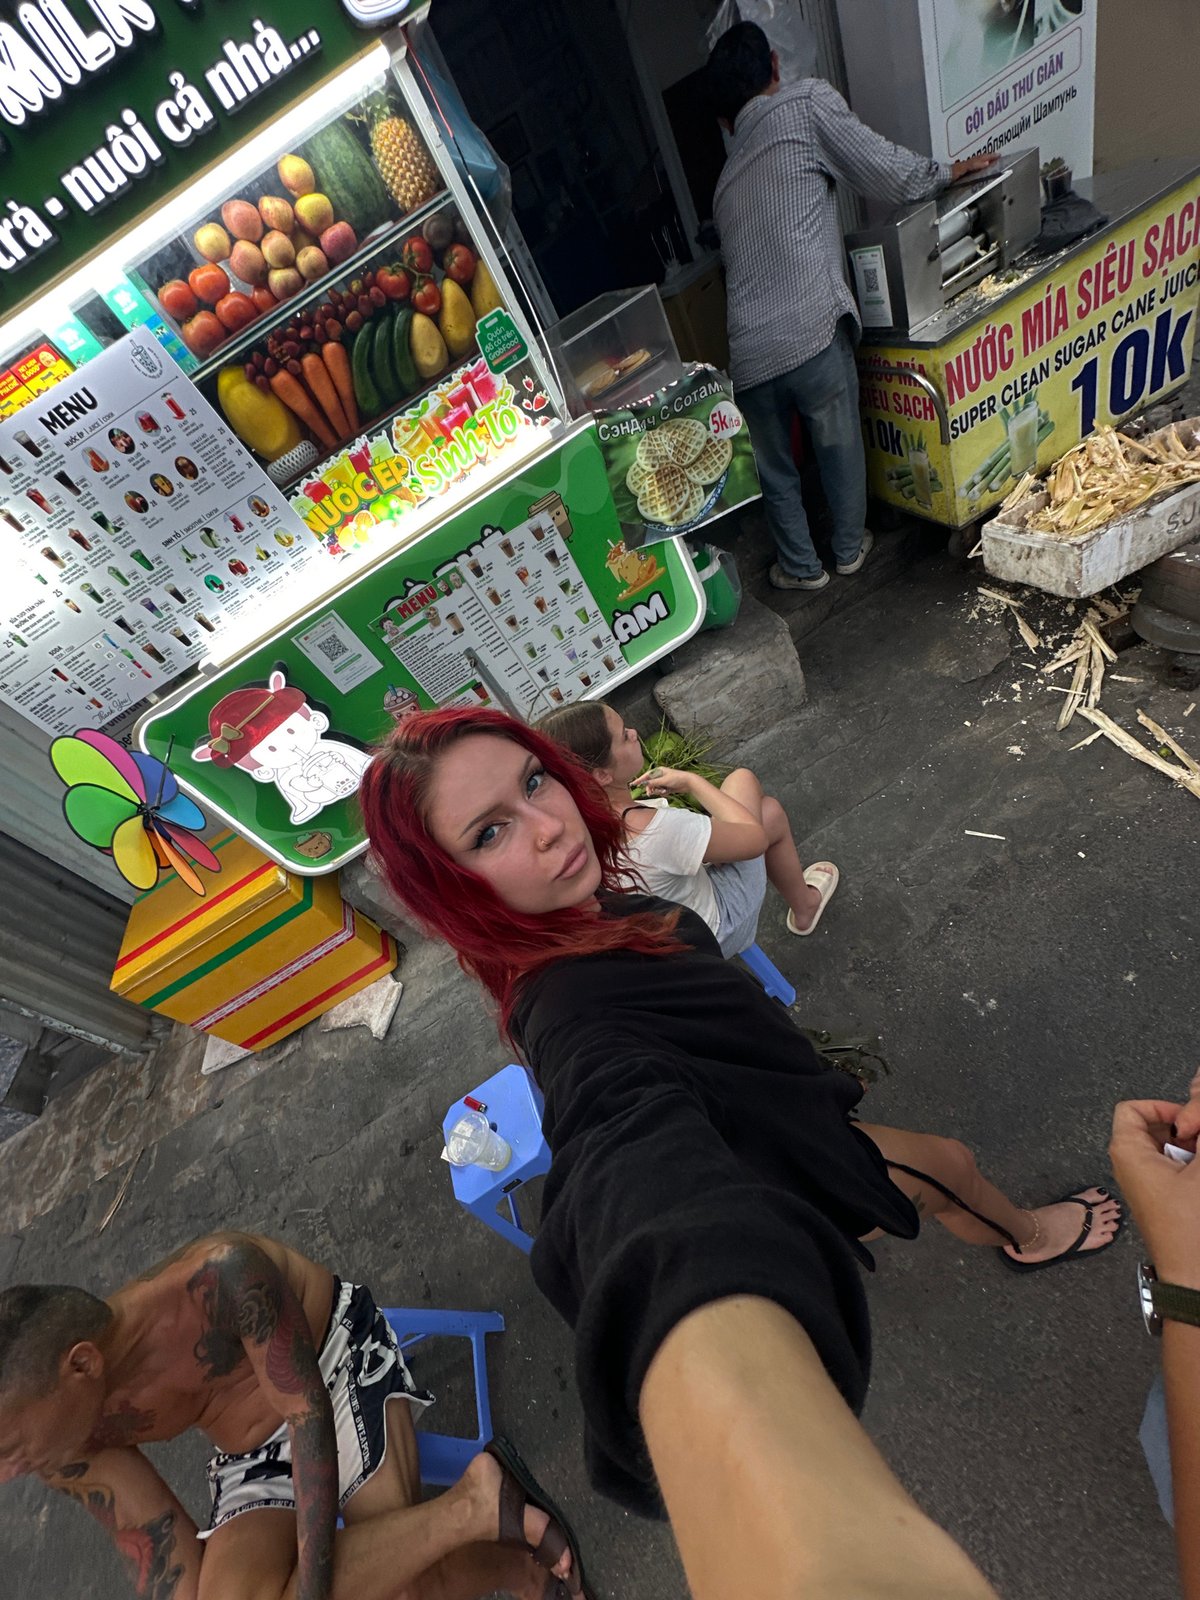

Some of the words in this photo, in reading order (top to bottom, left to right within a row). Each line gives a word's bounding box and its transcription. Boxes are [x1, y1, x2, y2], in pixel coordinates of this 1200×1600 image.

[965, 106, 985, 135] GỘI
[987, 88, 1010, 121] ĐẦU
[1012, 69, 1035, 102] THƯ
[1036, 51, 1064, 86] GIÃN
[1033, 85, 1077, 124] Шампунь
[61, 108, 162, 212] nuôi
[155, 71, 214, 142] cả
[487, 326, 505, 342] Quán
[945, 323, 1014, 407] NƯỚC
[1021, 283, 1069, 358] MÍA
[1077, 239, 1135, 320] SIÊU
[485, 342, 494, 353] đã
[493, 338, 502, 347] có
[501, 329, 515, 341] trên
[488, 336, 519, 361] GrabFood
[950, 394, 997, 440] SUPER
[1001, 358, 1050, 406] CLEAN
[1054, 321, 1107, 372] SUGAR
[1111, 288, 1156, 334] CANE
[1159, 262, 1200, 304] JUIC
[39, 387, 98, 437] MENU
[189, 407, 197, 416] 25
[711, 410, 729, 434] 5k
[892, 391, 935, 422] SẠCH
[64, 435, 79, 447] NƯỚC
[76, 431, 84, 439] ÉP
[88, 421, 101, 432] JUICE
[163, 424, 172, 433] 22
[415, 427, 485, 492] Sinh
[477, 387, 518, 444] Tố
[302, 472, 380, 541] NƯỚC
[370, 455, 410, 495] ÉP
[161, 537, 175, 547] SINH
[172, 530, 181, 540] TỐ
[52, 589, 63, 598] 25
[396, 586, 439, 618] MENU
[610, 591, 668, 645] ÀM
[3, 639, 14, 648] 25
[48, 645, 63, 656] SODA
[91, 705, 115, 724] Thank
[111, 692, 133, 711] You!
